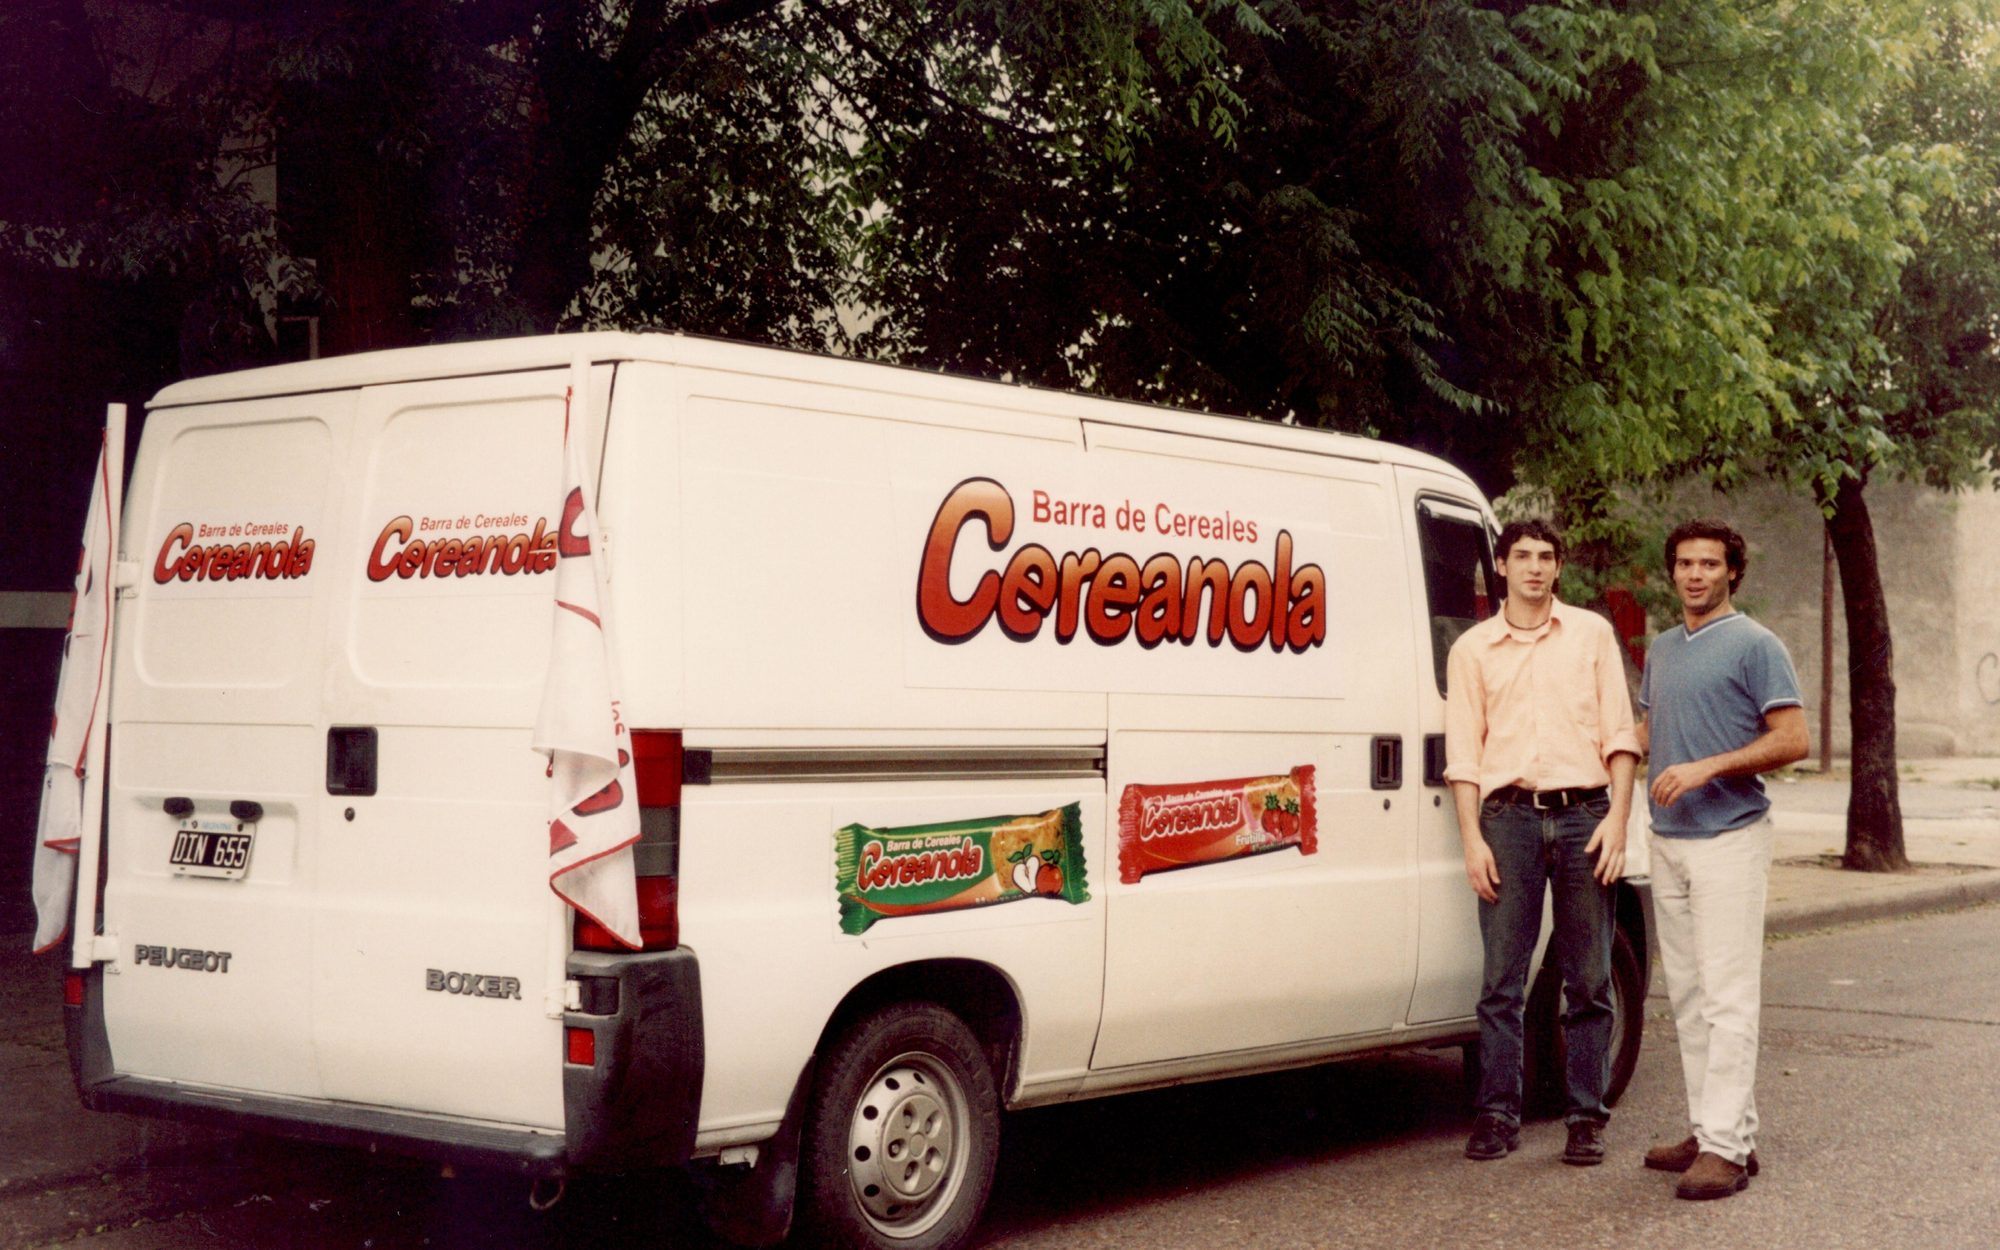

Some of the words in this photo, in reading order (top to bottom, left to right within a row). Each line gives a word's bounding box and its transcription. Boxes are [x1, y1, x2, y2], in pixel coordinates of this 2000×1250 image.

[199, 523, 226, 538] Barra
[229, 523, 241, 537] de
[244, 521, 288, 537] Cereales
[420, 516, 452, 531] Barra
[456, 515, 470, 530] de
[474, 512, 528, 528] Cereales
[1032, 489, 1106, 529] Barra
[1116, 499, 1146, 533] de
[1154, 502, 1258, 543] Cereales
[153, 522, 315, 585] Cereanola
[367, 515, 558, 582] Cereanola
[916, 476, 1326, 655] Cereanola
[1140, 790, 1241, 842] Cereanola
[171, 832, 209, 864] DIN
[213, 836, 249, 867] 655
[857, 836, 983, 893] Cereanola
[886, 839, 910, 852] Barra
[912, 837, 923, 849] de
[925, 834, 962, 847] Cereales
[134, 943, 232, 974] PEUGEOT
[426, 968, 522, 1001] BOXER
